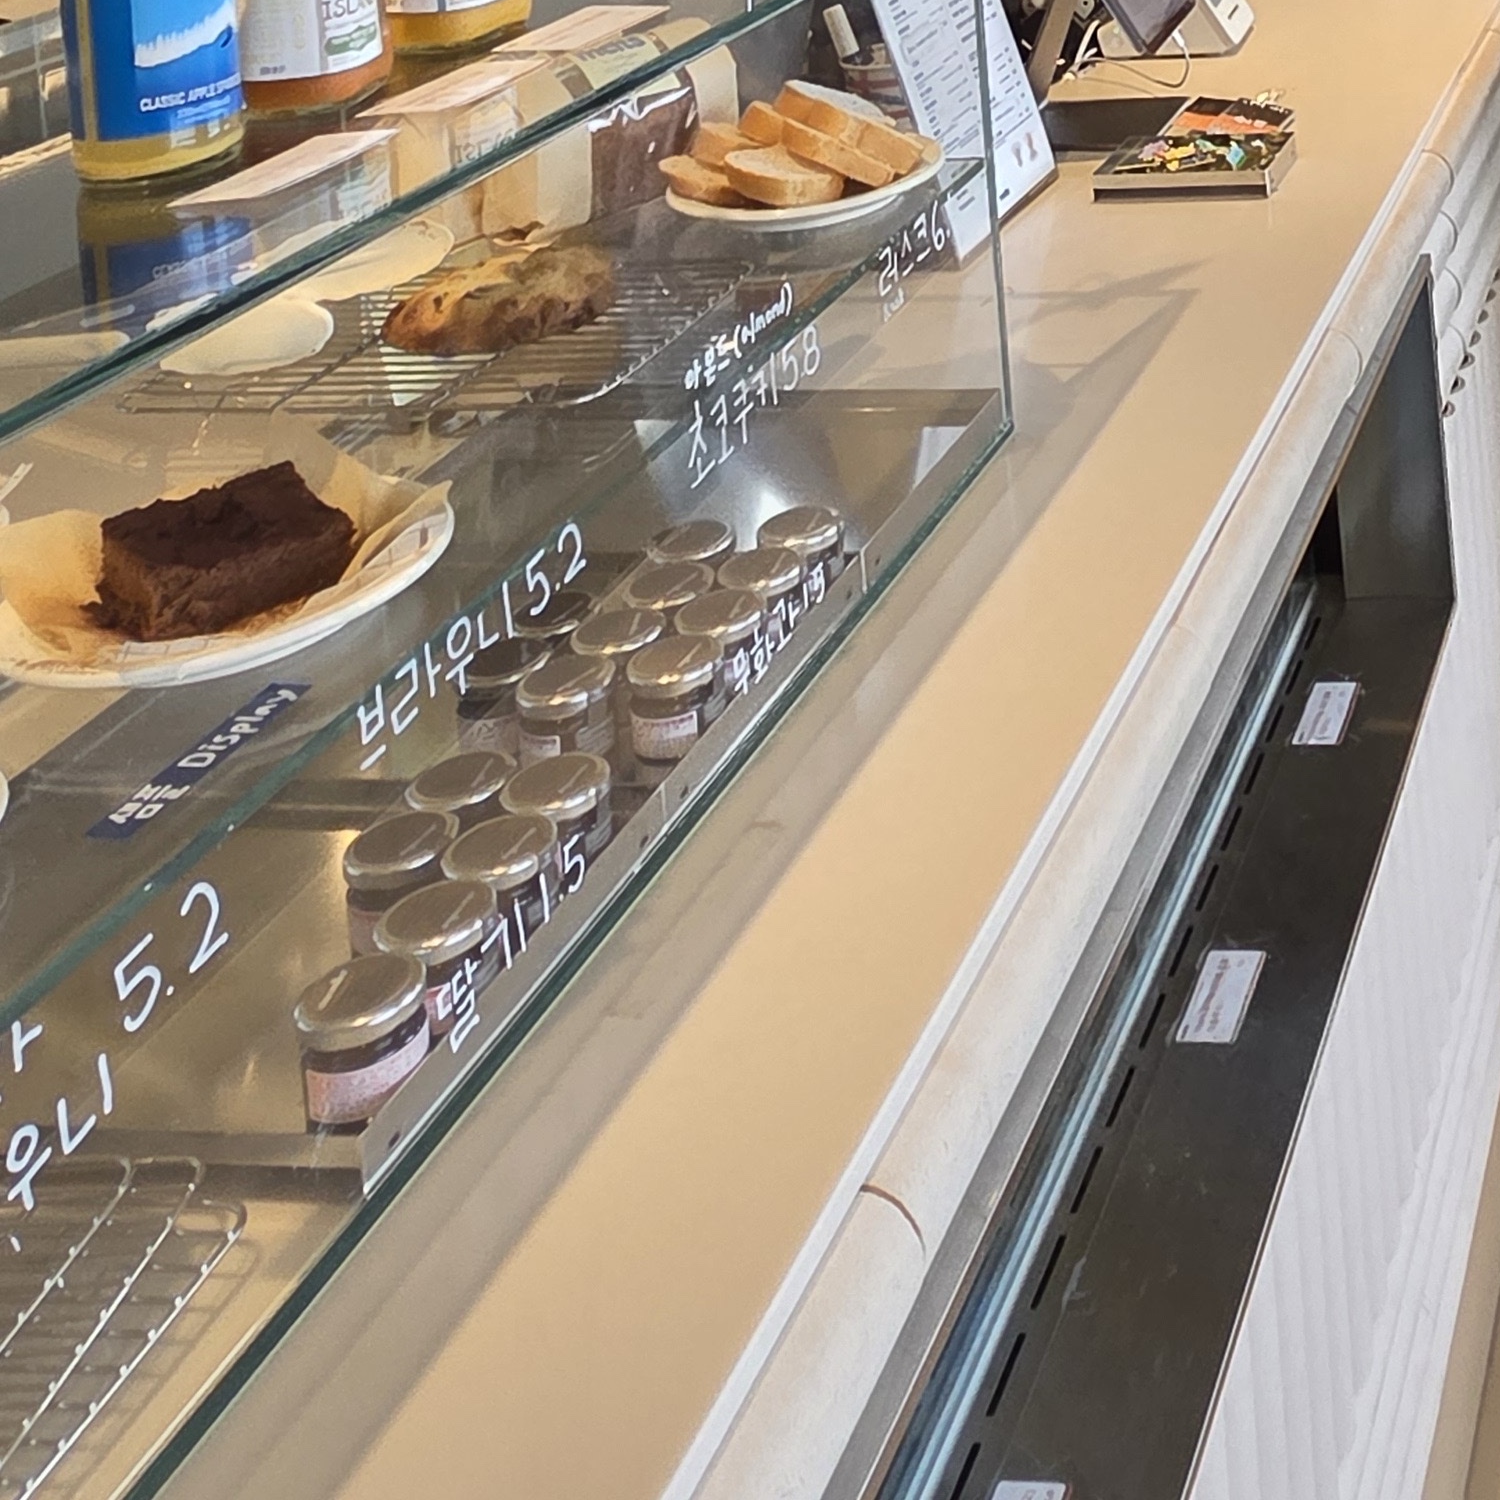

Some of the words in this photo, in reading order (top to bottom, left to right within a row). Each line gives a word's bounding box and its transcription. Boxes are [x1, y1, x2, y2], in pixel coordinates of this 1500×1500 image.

[140, 91, 186, 112] CLASSIC
[688, 352, 779, 489] 초코쿠키
[782, 323, 821, 391] 5.8
[357, 581, 516, 771] 브라우니
[526, 523, 587, 617] 5.2
[177, 689, 298, 767] Display
[114, 882, 229, 1033] 5.2
[433, 897, 527, 1054] 딸기
[538, 831, 586, 924] 1.5
